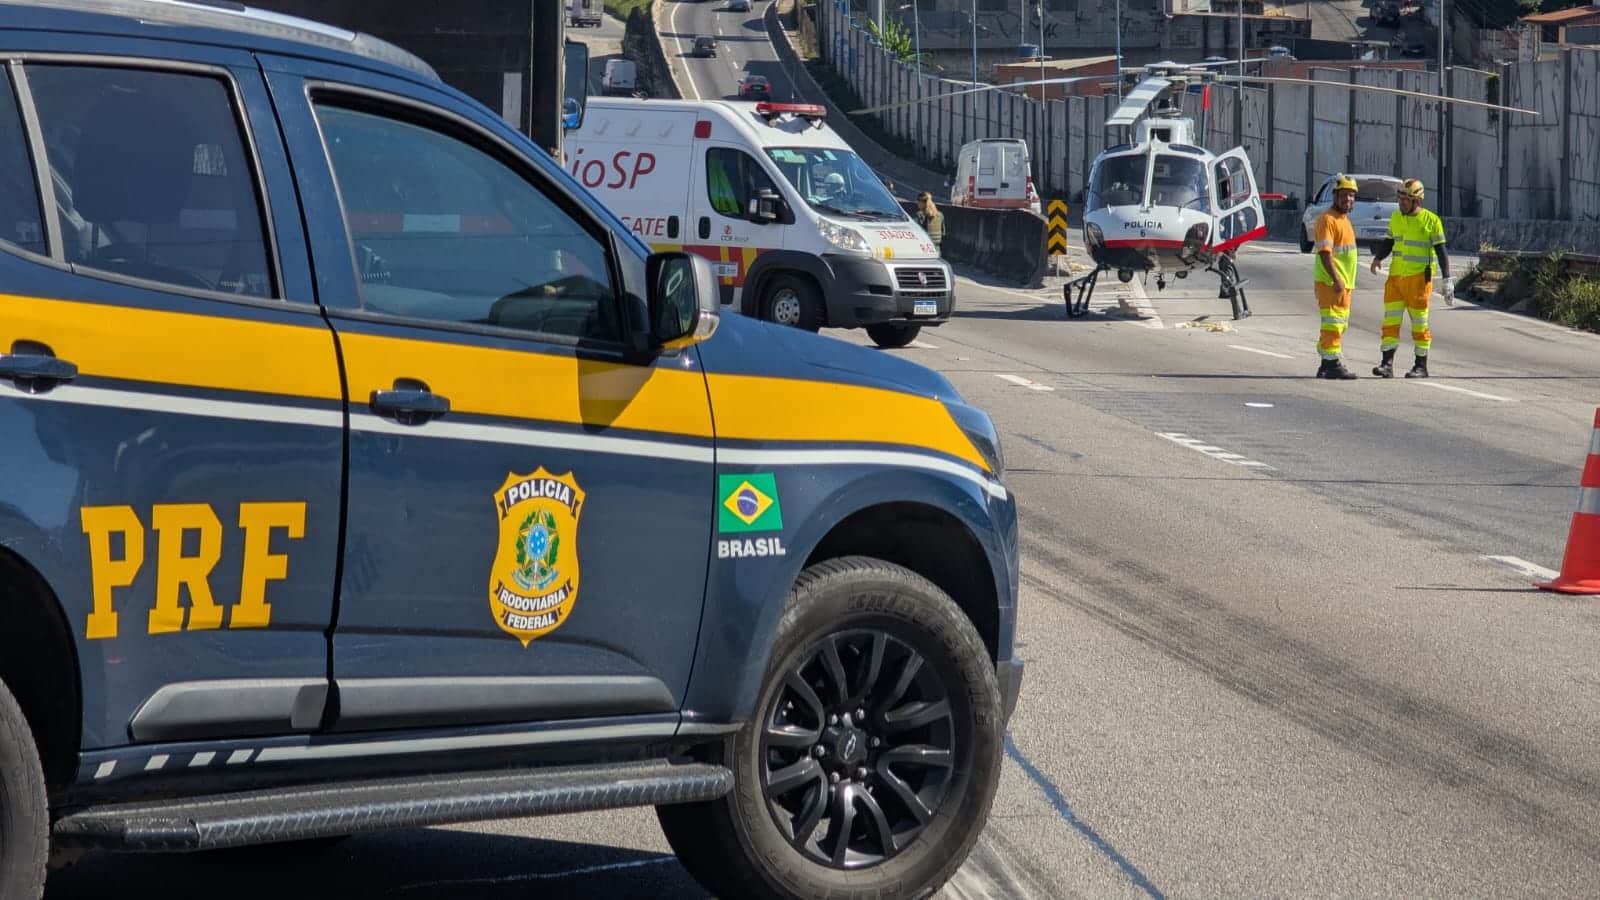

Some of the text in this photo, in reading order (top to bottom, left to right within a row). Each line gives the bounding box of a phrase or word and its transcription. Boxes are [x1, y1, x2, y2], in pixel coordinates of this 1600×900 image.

[565, 148, 656, 190] ioSP
[718, 536, 786, 559] BRASIL
[80, 501, 307, 640] PRF
[507, 612, 555, 630] FEDERAL
